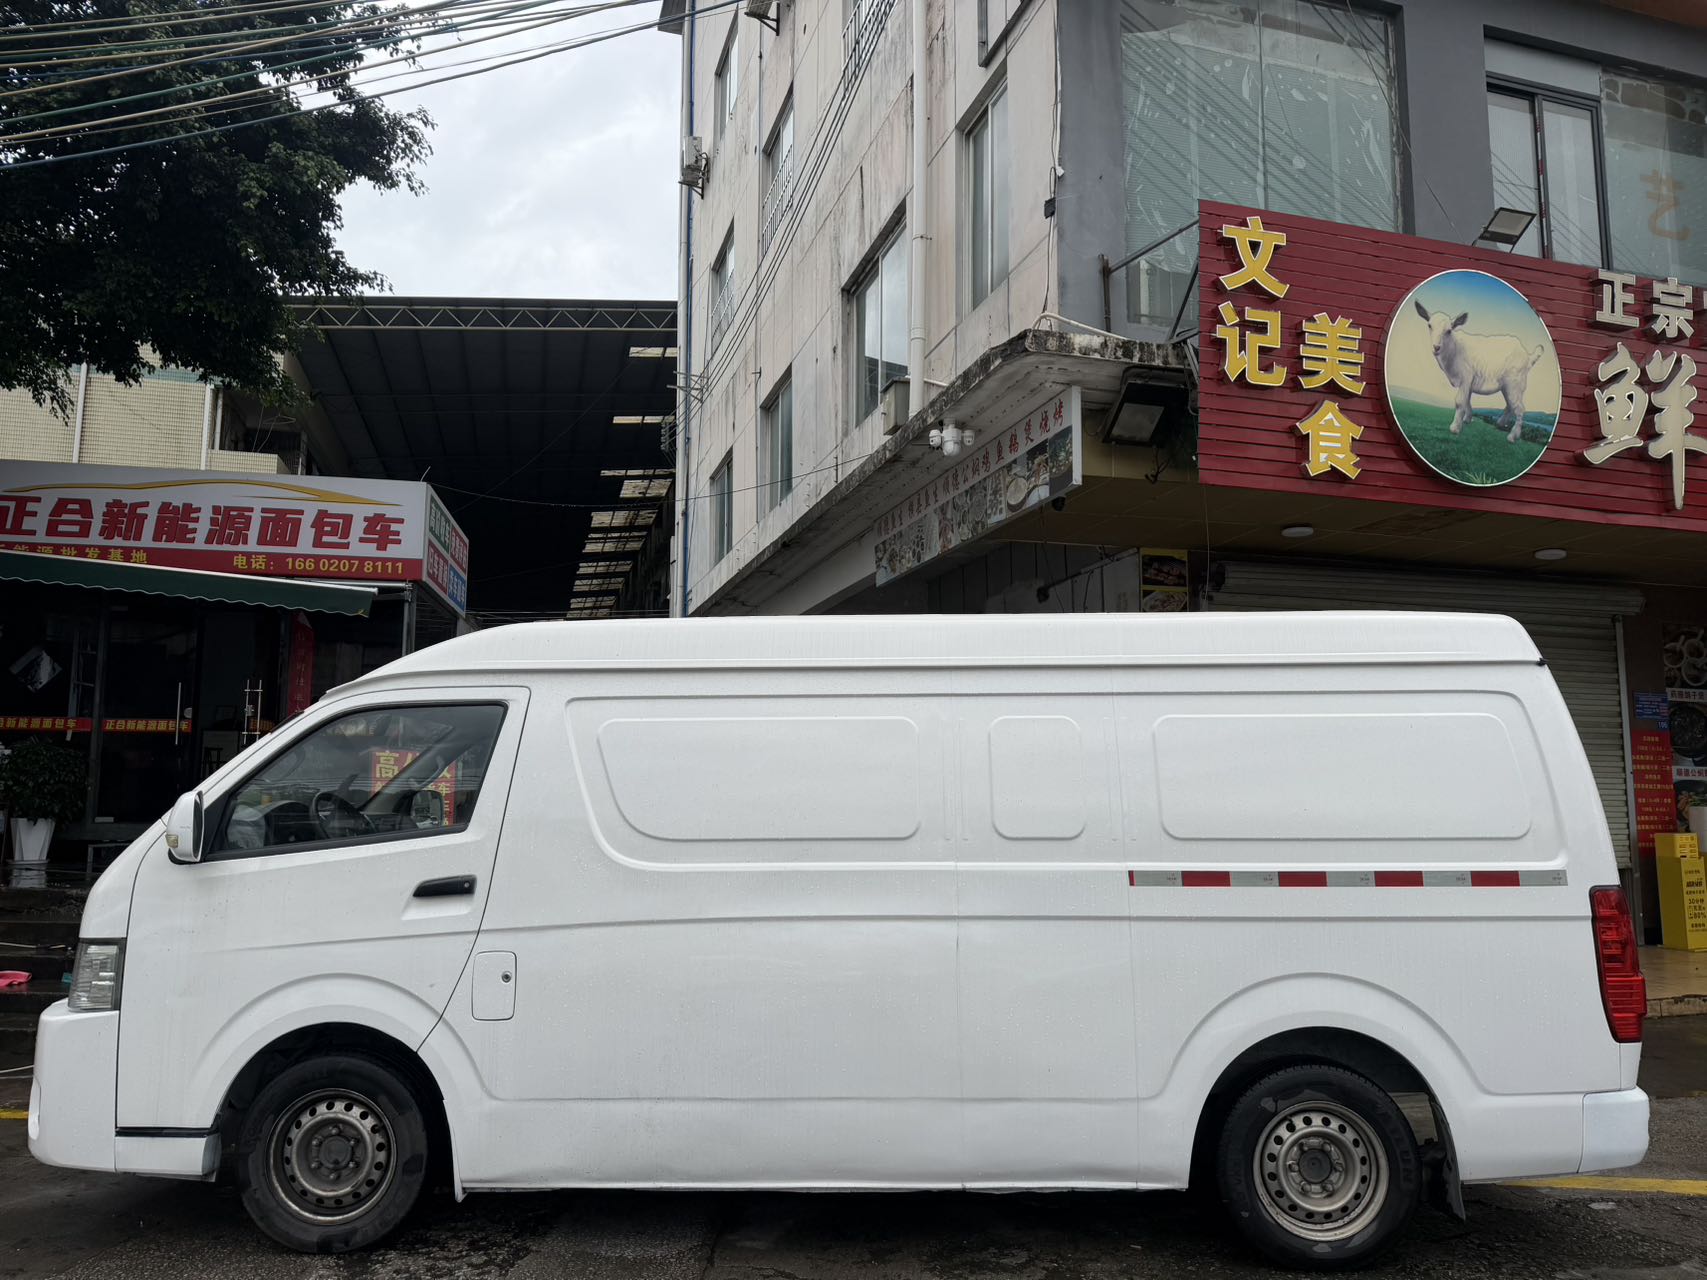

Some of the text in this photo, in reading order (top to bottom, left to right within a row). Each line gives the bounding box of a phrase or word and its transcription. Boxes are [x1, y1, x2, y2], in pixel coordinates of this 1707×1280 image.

[1216, 215, 1290, 388] 文记
[1596, 268, 1707, 338] 正宗
[1297, 312, 1367, 481] 美食
[0, 494, 406, 552] 正合新能源面包车
[286, 557, 315, 571] 166
[319, 558, 360, 573] 0207
[363, 559, 404, 574] 8111
